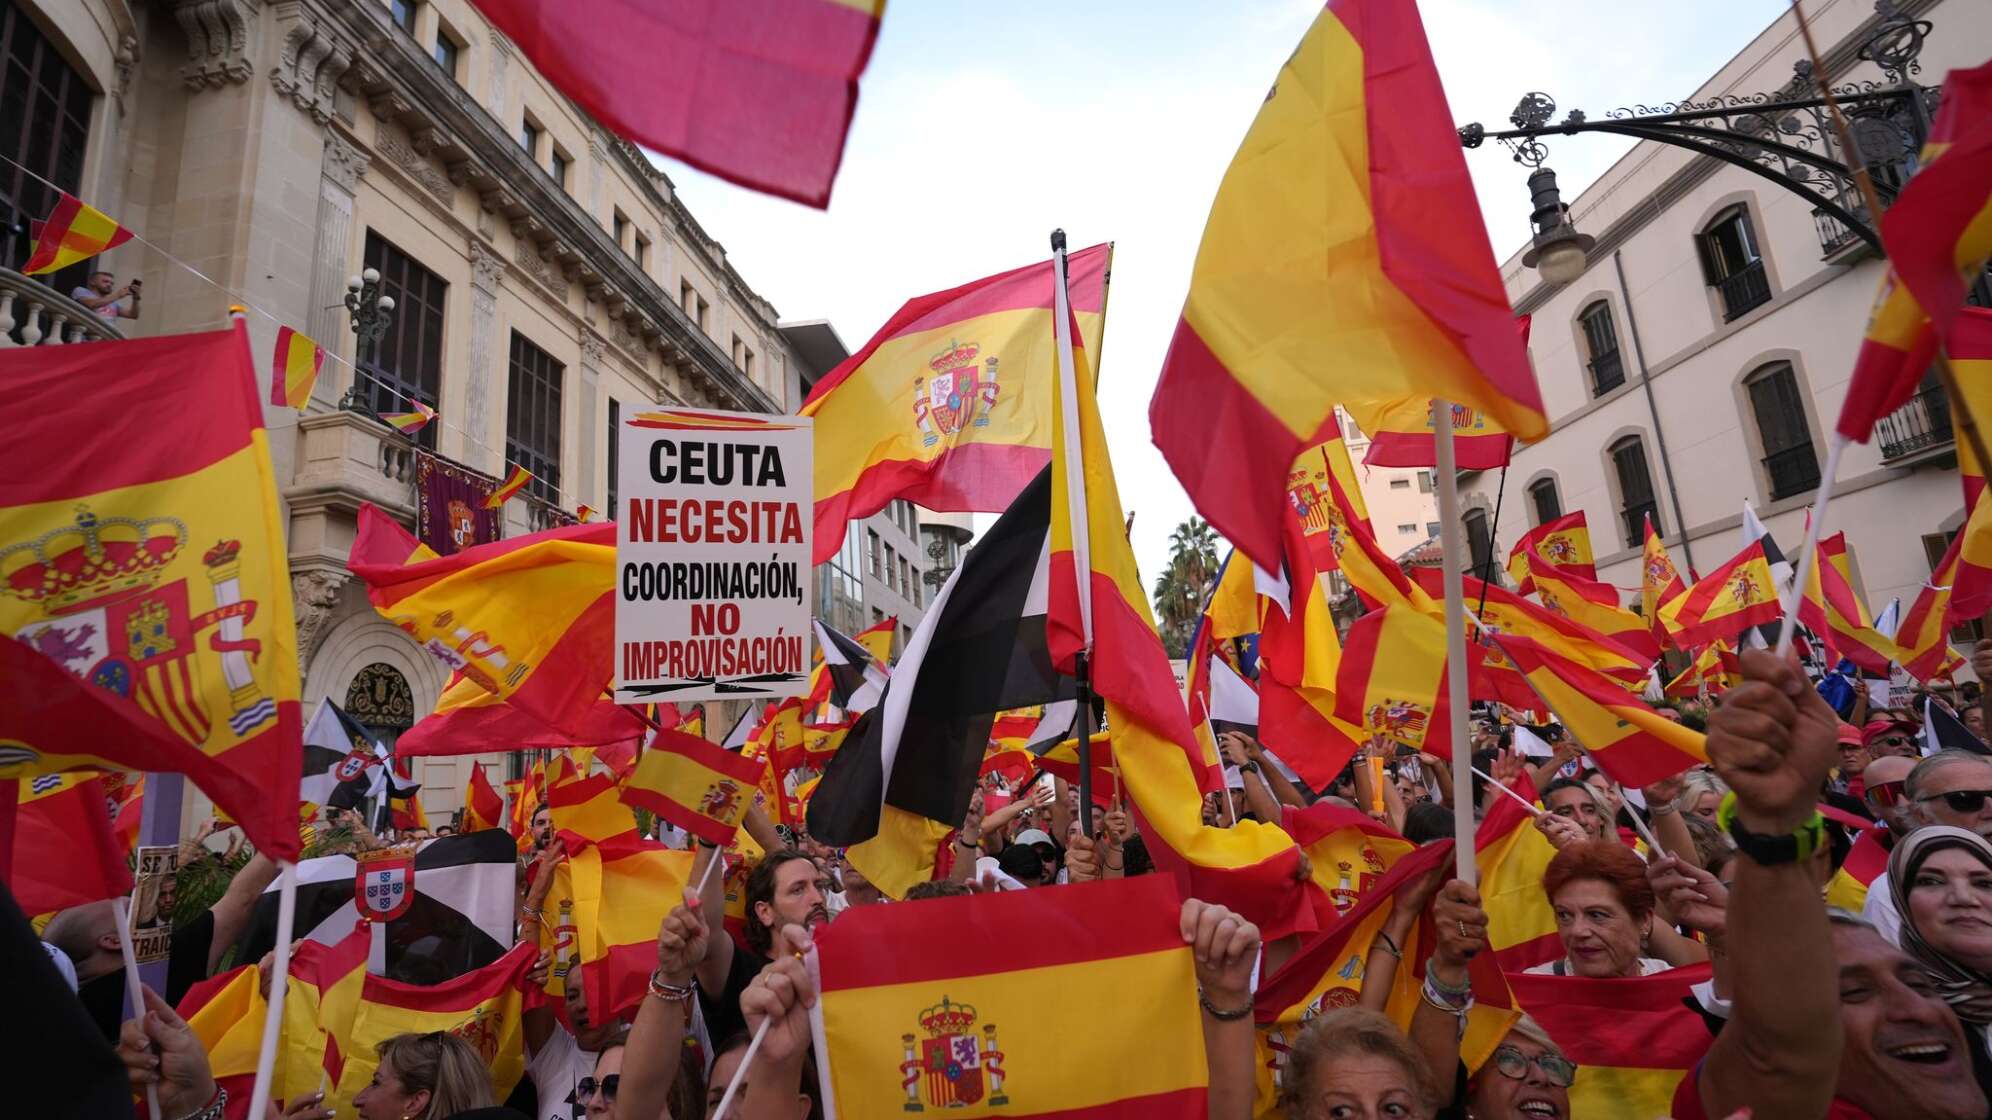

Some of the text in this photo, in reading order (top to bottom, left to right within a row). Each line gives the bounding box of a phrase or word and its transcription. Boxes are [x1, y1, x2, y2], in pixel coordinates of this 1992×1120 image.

[649, 439, 786, 487] CEUTA
[629, 498, 804, 544] NECESITA
[623, 553, 803, 605] COORDINACIÓN,
[691, 603, 741, 636] NO
[623, 627, 802, 681] IMPROVISACIÓN
[142, 856, 161, 873] SE
